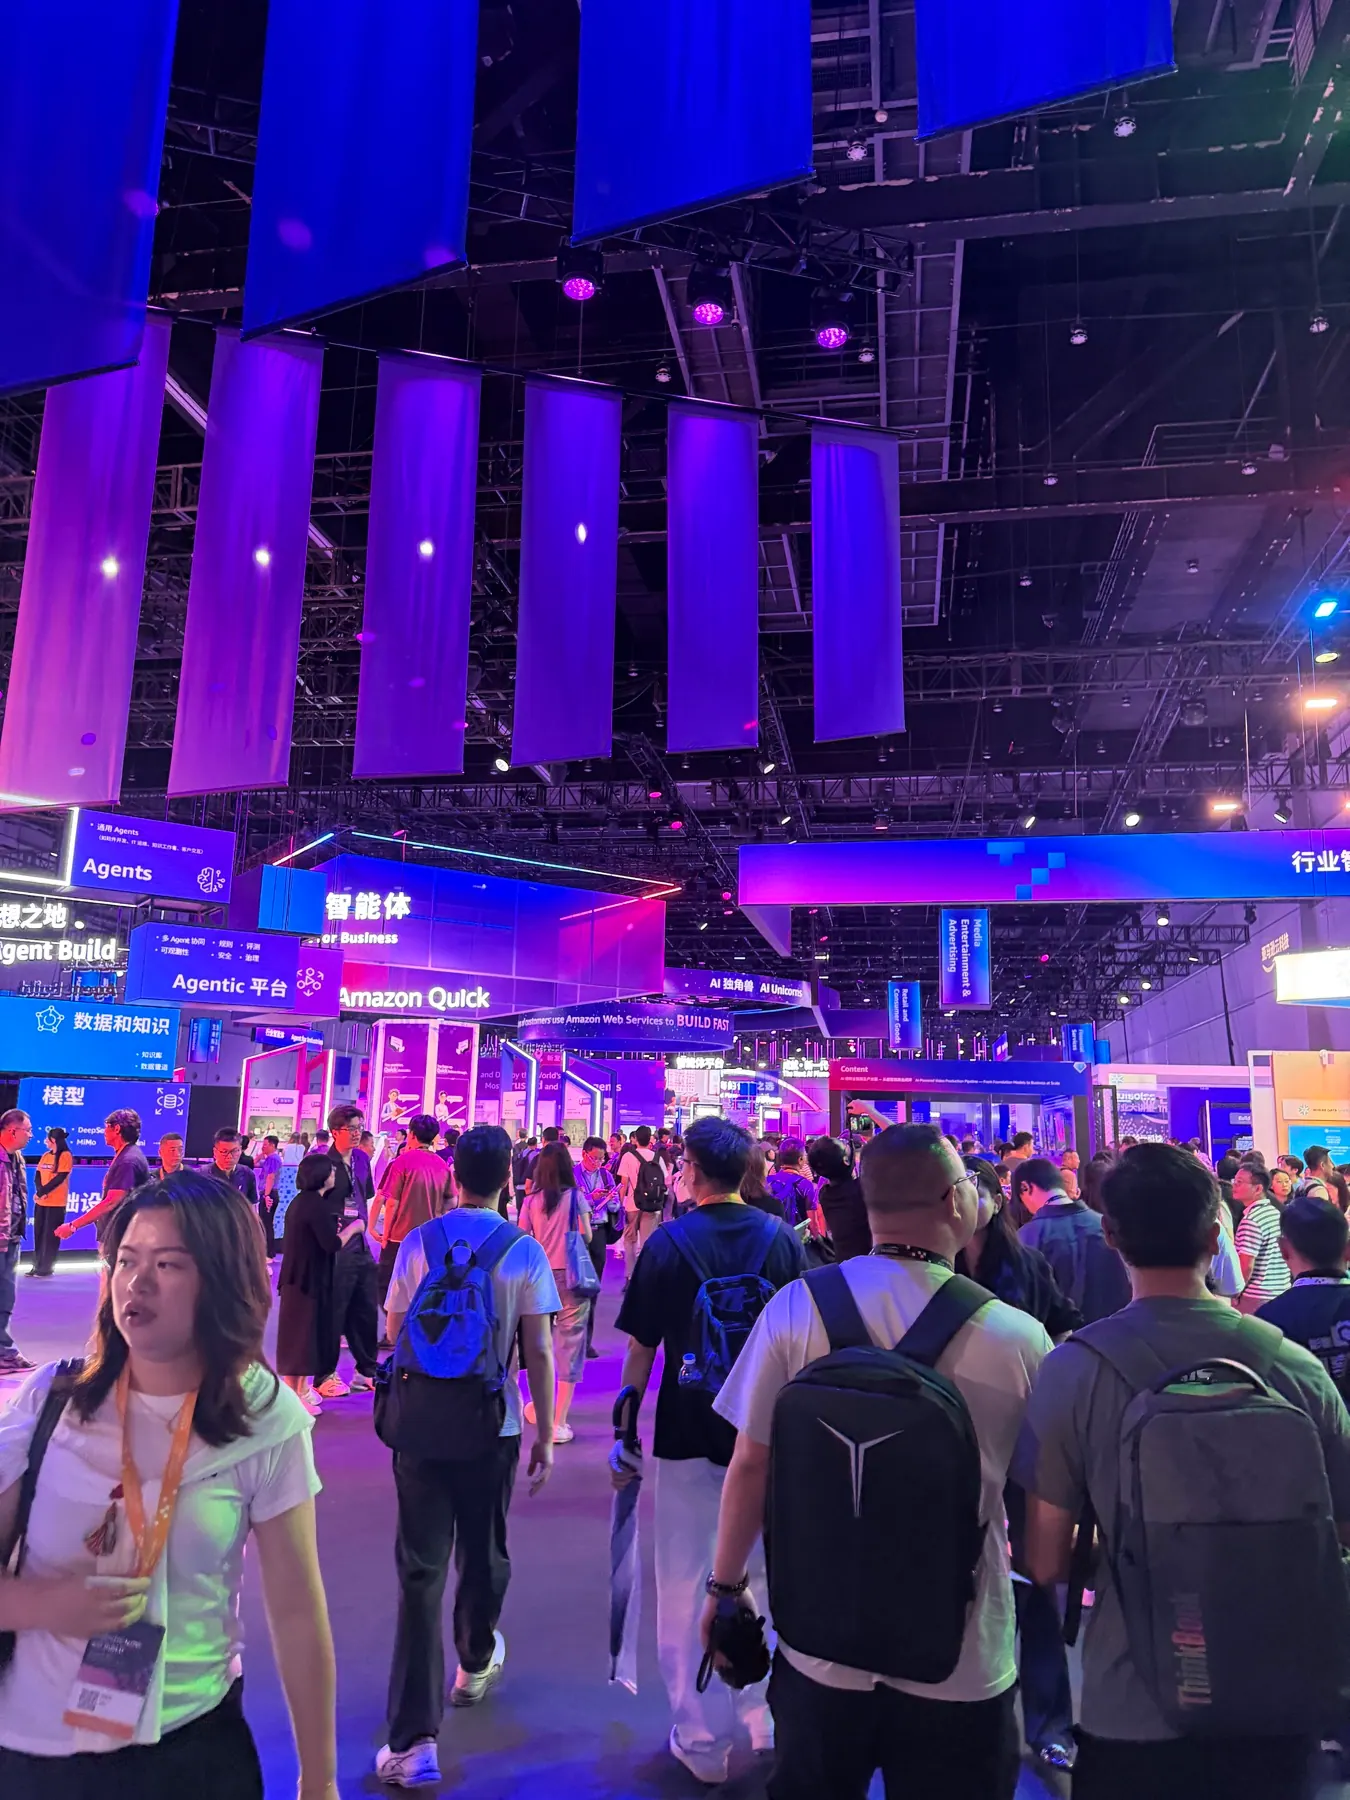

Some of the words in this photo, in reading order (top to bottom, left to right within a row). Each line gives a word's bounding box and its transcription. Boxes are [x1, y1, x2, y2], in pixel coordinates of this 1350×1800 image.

[96, 823, 112, 832] 通用
[114, 826, 139, 836] Agents
[82, 858, 153, 882] Agents
[326, 892, 412, 920] 智能体
[170, 936, 190, 945] Agent
[340, 931, 398, 944] Business
[974, 918, 983, 947] Media
[58, 938, 116, 961] Build
[218, 952, 232, 960] 安全
[947, 918, 958, 973] Advertising
[960, 919, 971, 988] Entertainment
[172, 974, 245, 994] Agentic
[250, 978, 288, 998] 平台
[710, 977, 722, 988] AI
[723, 978, 754, 992] 独角兽
[760, 982, 770, 993] AI
[772, 984, 802, 998] Unicorns
[962, 990, 972, 998] &
[340, 987, 422, 1008] Amazon
[428, 986, 490, 1011] Quick
[73, 1012, 170, 1036] 数据和知识
[552, 1016, 565, 1024] use
[566, 1014, 600, 1024] Amazon
[602, 1014, 623, 1024] Web
[626, 1014, 663, 1026] Services
[665, 1016, 674, 1026] to
[676, 1014, 711, 1028] BUILD
[713, 1018, 730, 1032] FAST
[894, 1022, 902, 1044] Goods
[142, 1051, 162, 1059] 知识库
[42, 1085, 85, 1106] 模型
[78, 1126, 105, 1135] DeepSe
[66, 1192, 102, 1214] 础设
